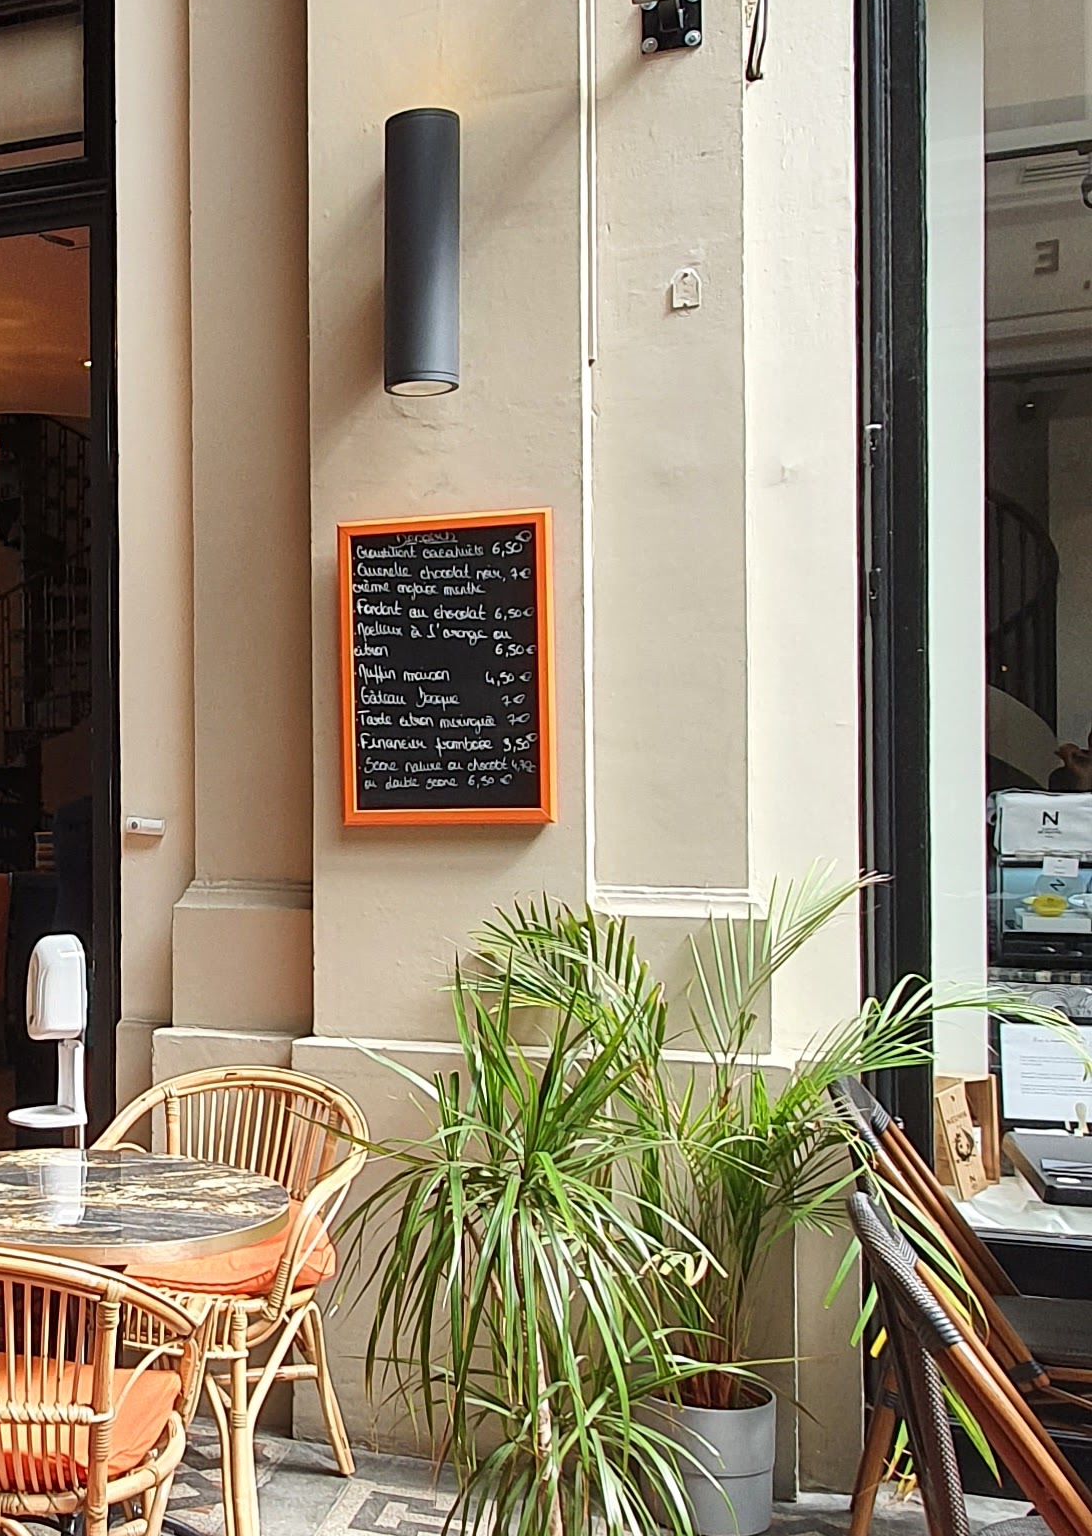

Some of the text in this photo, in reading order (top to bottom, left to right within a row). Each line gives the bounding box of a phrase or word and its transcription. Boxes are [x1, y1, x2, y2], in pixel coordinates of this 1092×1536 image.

[419, 564, 471, 580] chocolat
[408, 607, 429, 619] au
[433, 604, 487, 620] chocolat
[403, 669, 450, 682] maison
